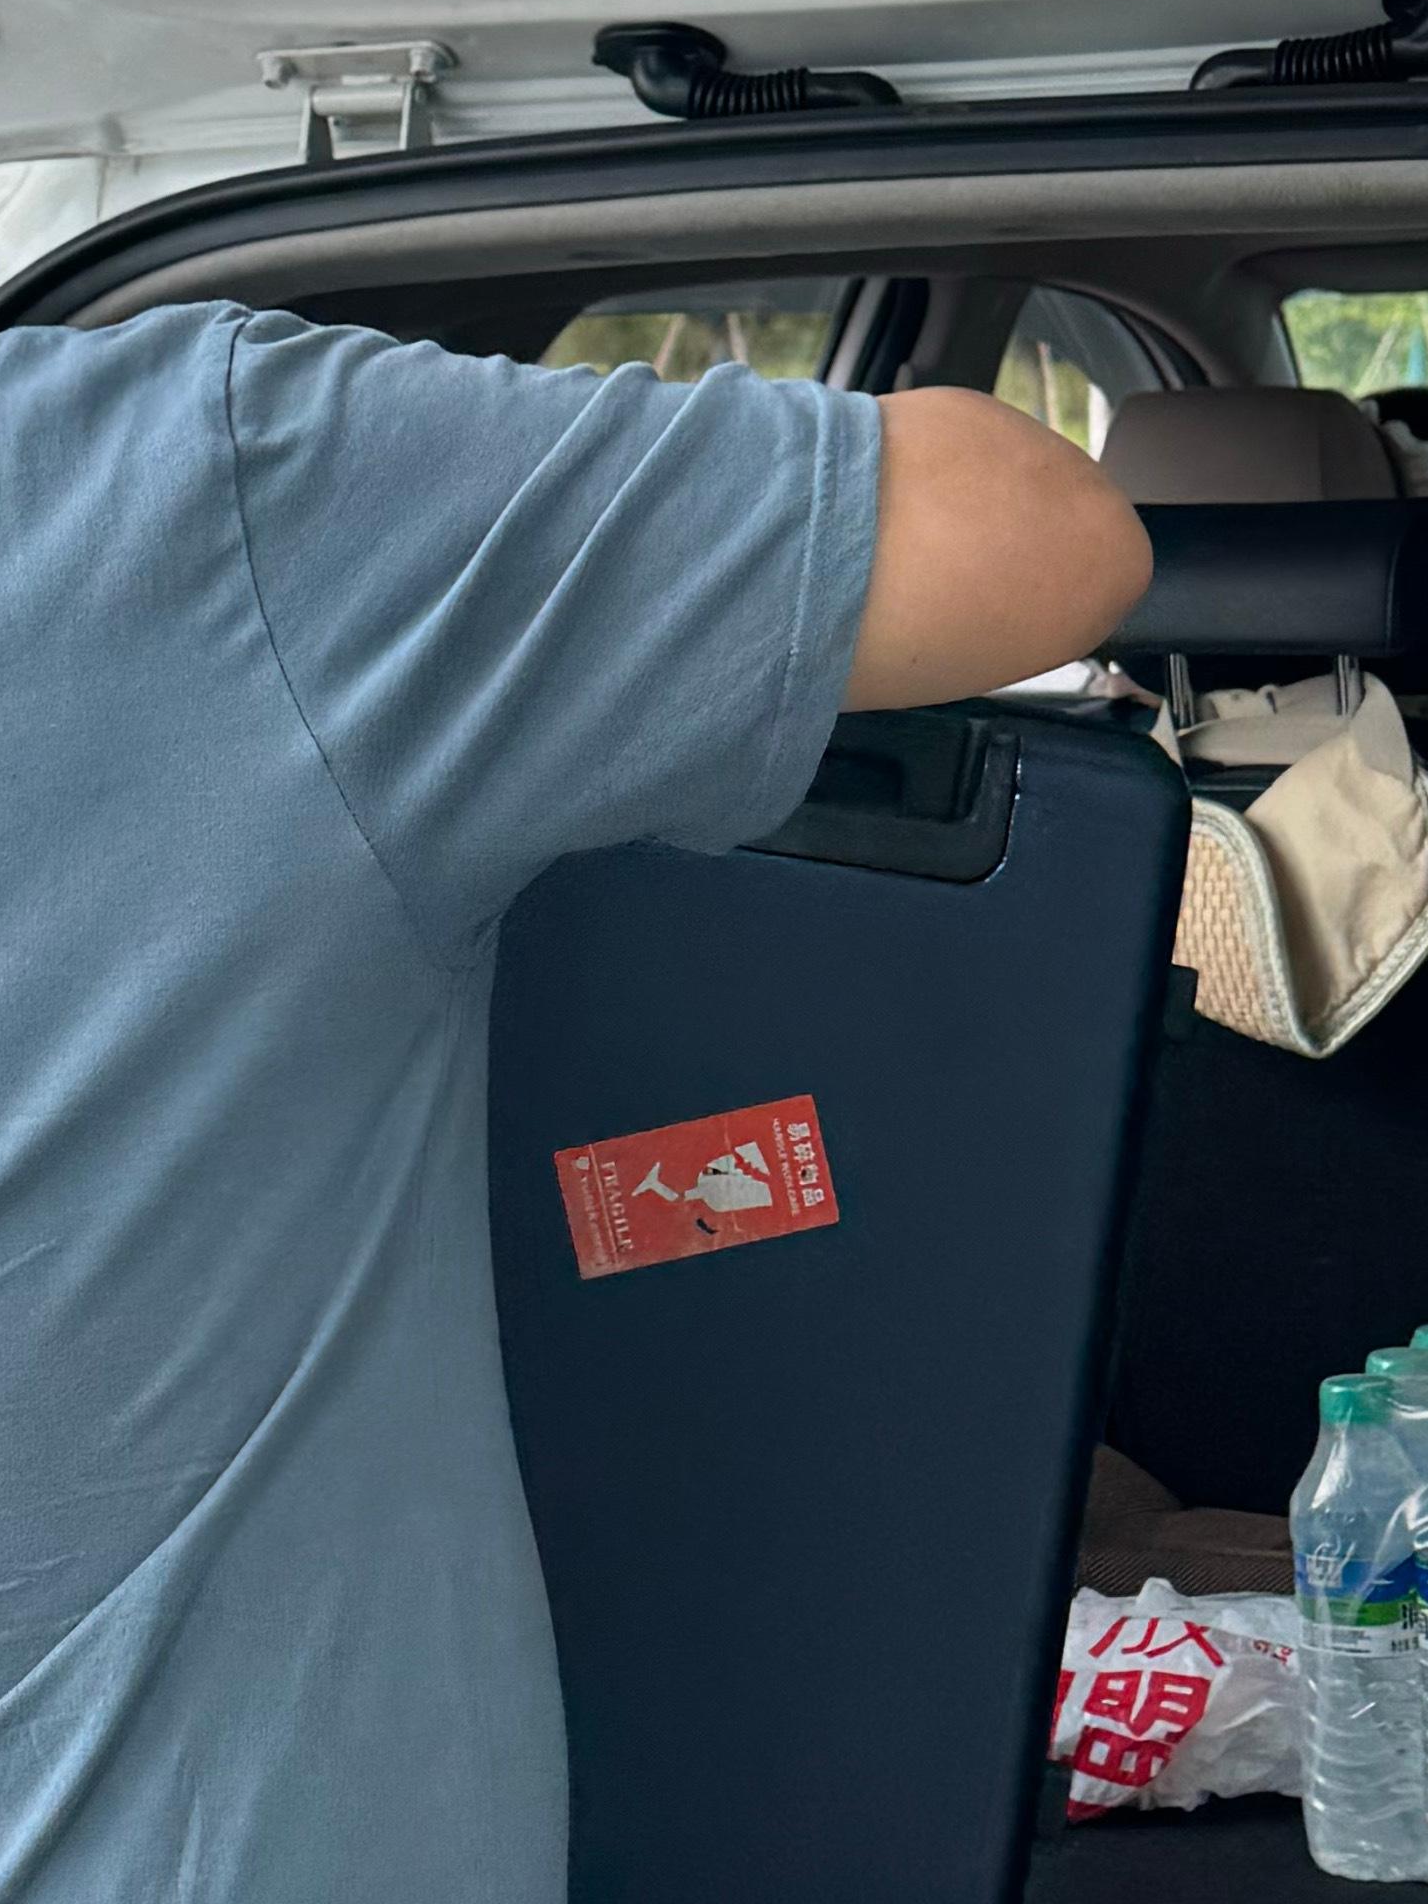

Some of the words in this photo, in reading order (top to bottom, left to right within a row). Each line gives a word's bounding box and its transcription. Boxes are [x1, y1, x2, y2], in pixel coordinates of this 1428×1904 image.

[601, 1161, 634, 1252] FRAGILE
[787, 1122, 825, 1207] 易碎物品
